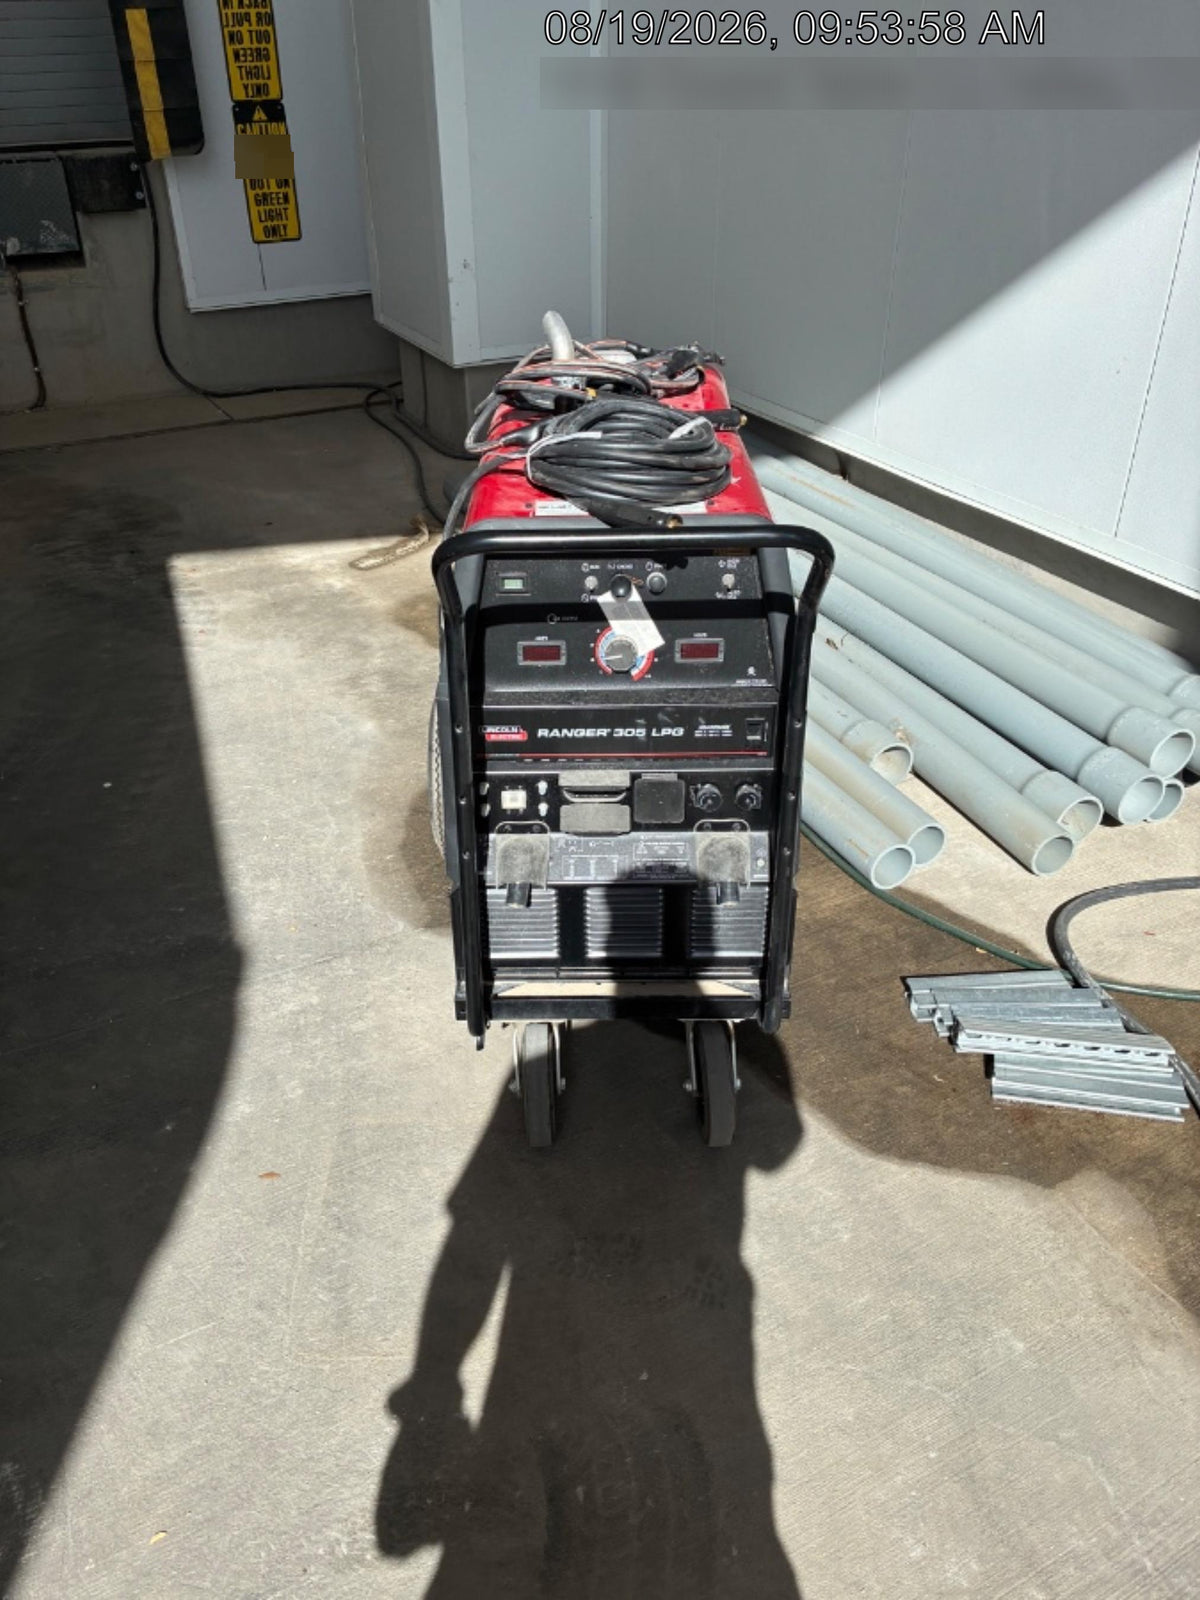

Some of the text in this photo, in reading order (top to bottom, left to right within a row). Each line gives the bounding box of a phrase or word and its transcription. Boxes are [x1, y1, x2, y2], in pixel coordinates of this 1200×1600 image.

[237, 122, 286, 135] CAUTION
[253, 191, 290, 208] GREEN
[256, 207, 289, 223] LIGHT
[262, 223, 289, 239] ONLY
[612, 727, 647, 738] 305
[650, 727, 685, 738] LPG
